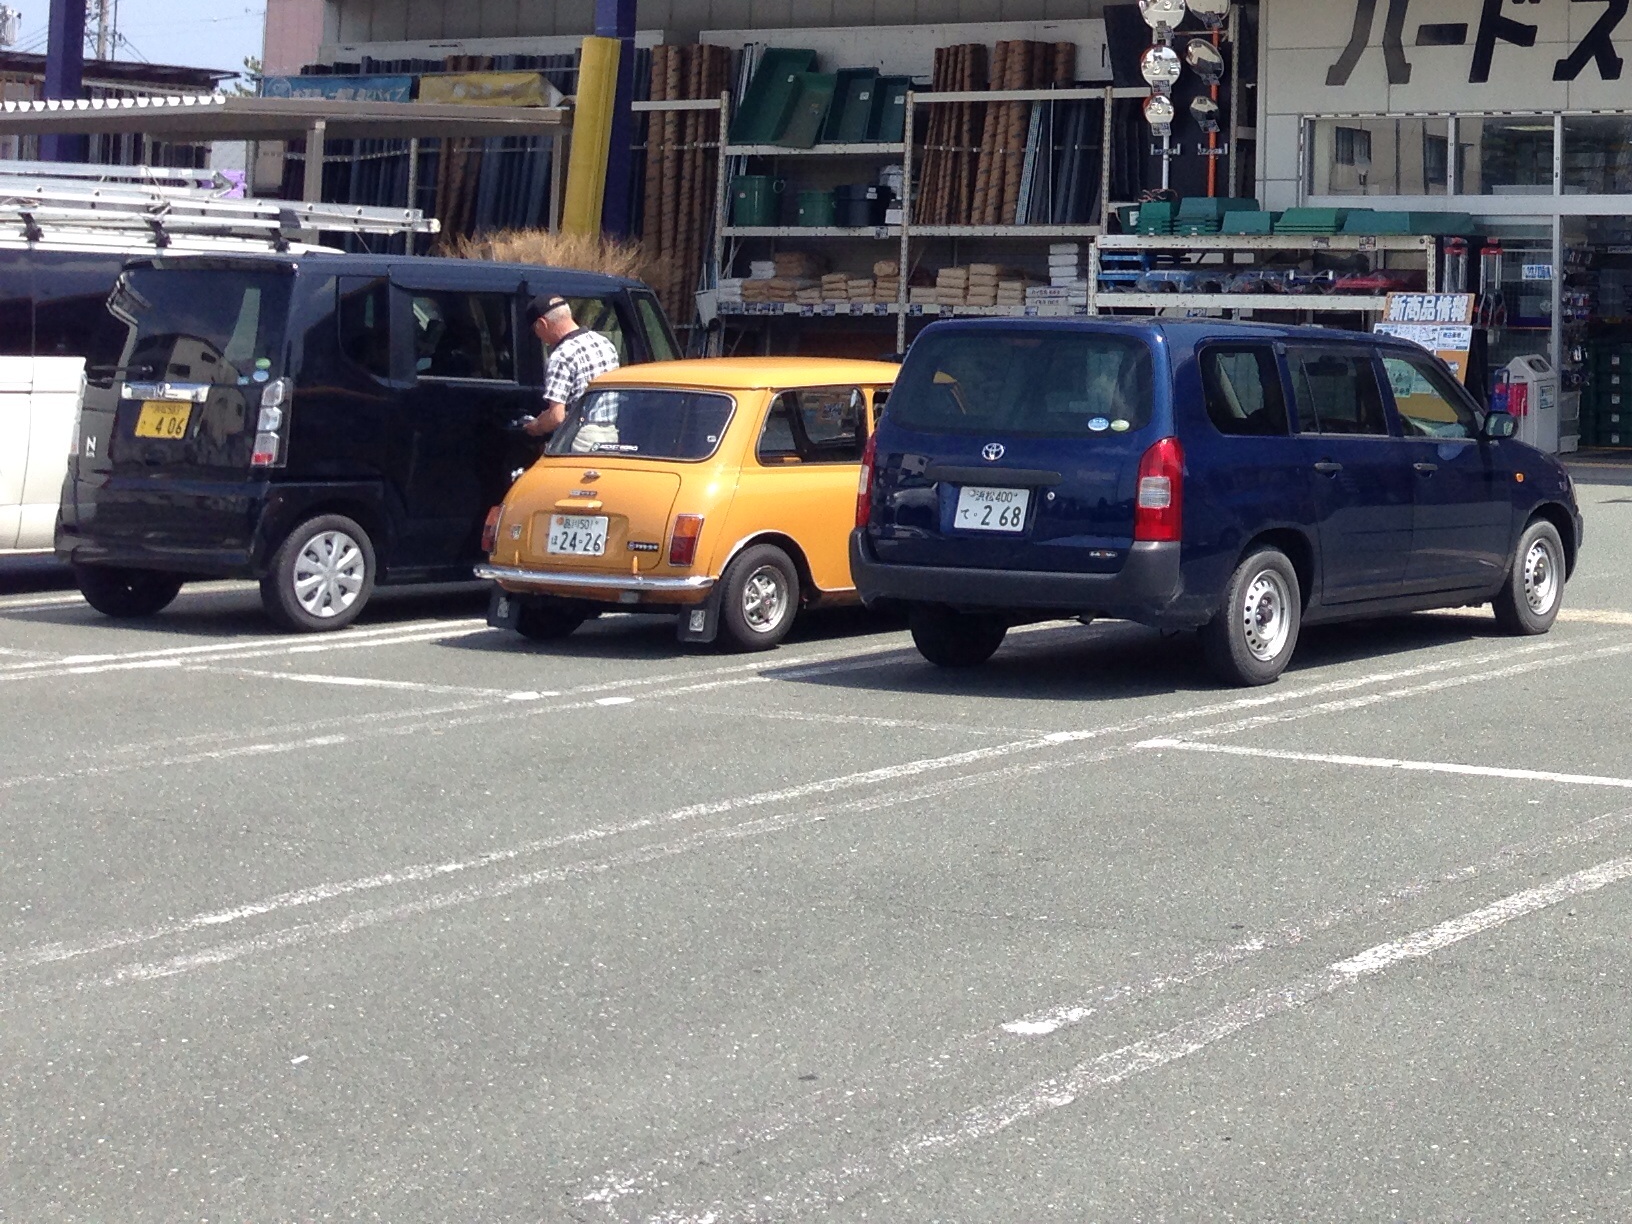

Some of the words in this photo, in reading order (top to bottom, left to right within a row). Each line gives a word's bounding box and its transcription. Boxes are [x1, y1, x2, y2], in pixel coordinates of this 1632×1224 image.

[1389, 295, 1469, 322] 新商品情報
[559, 530, 603, 552] 24-26
